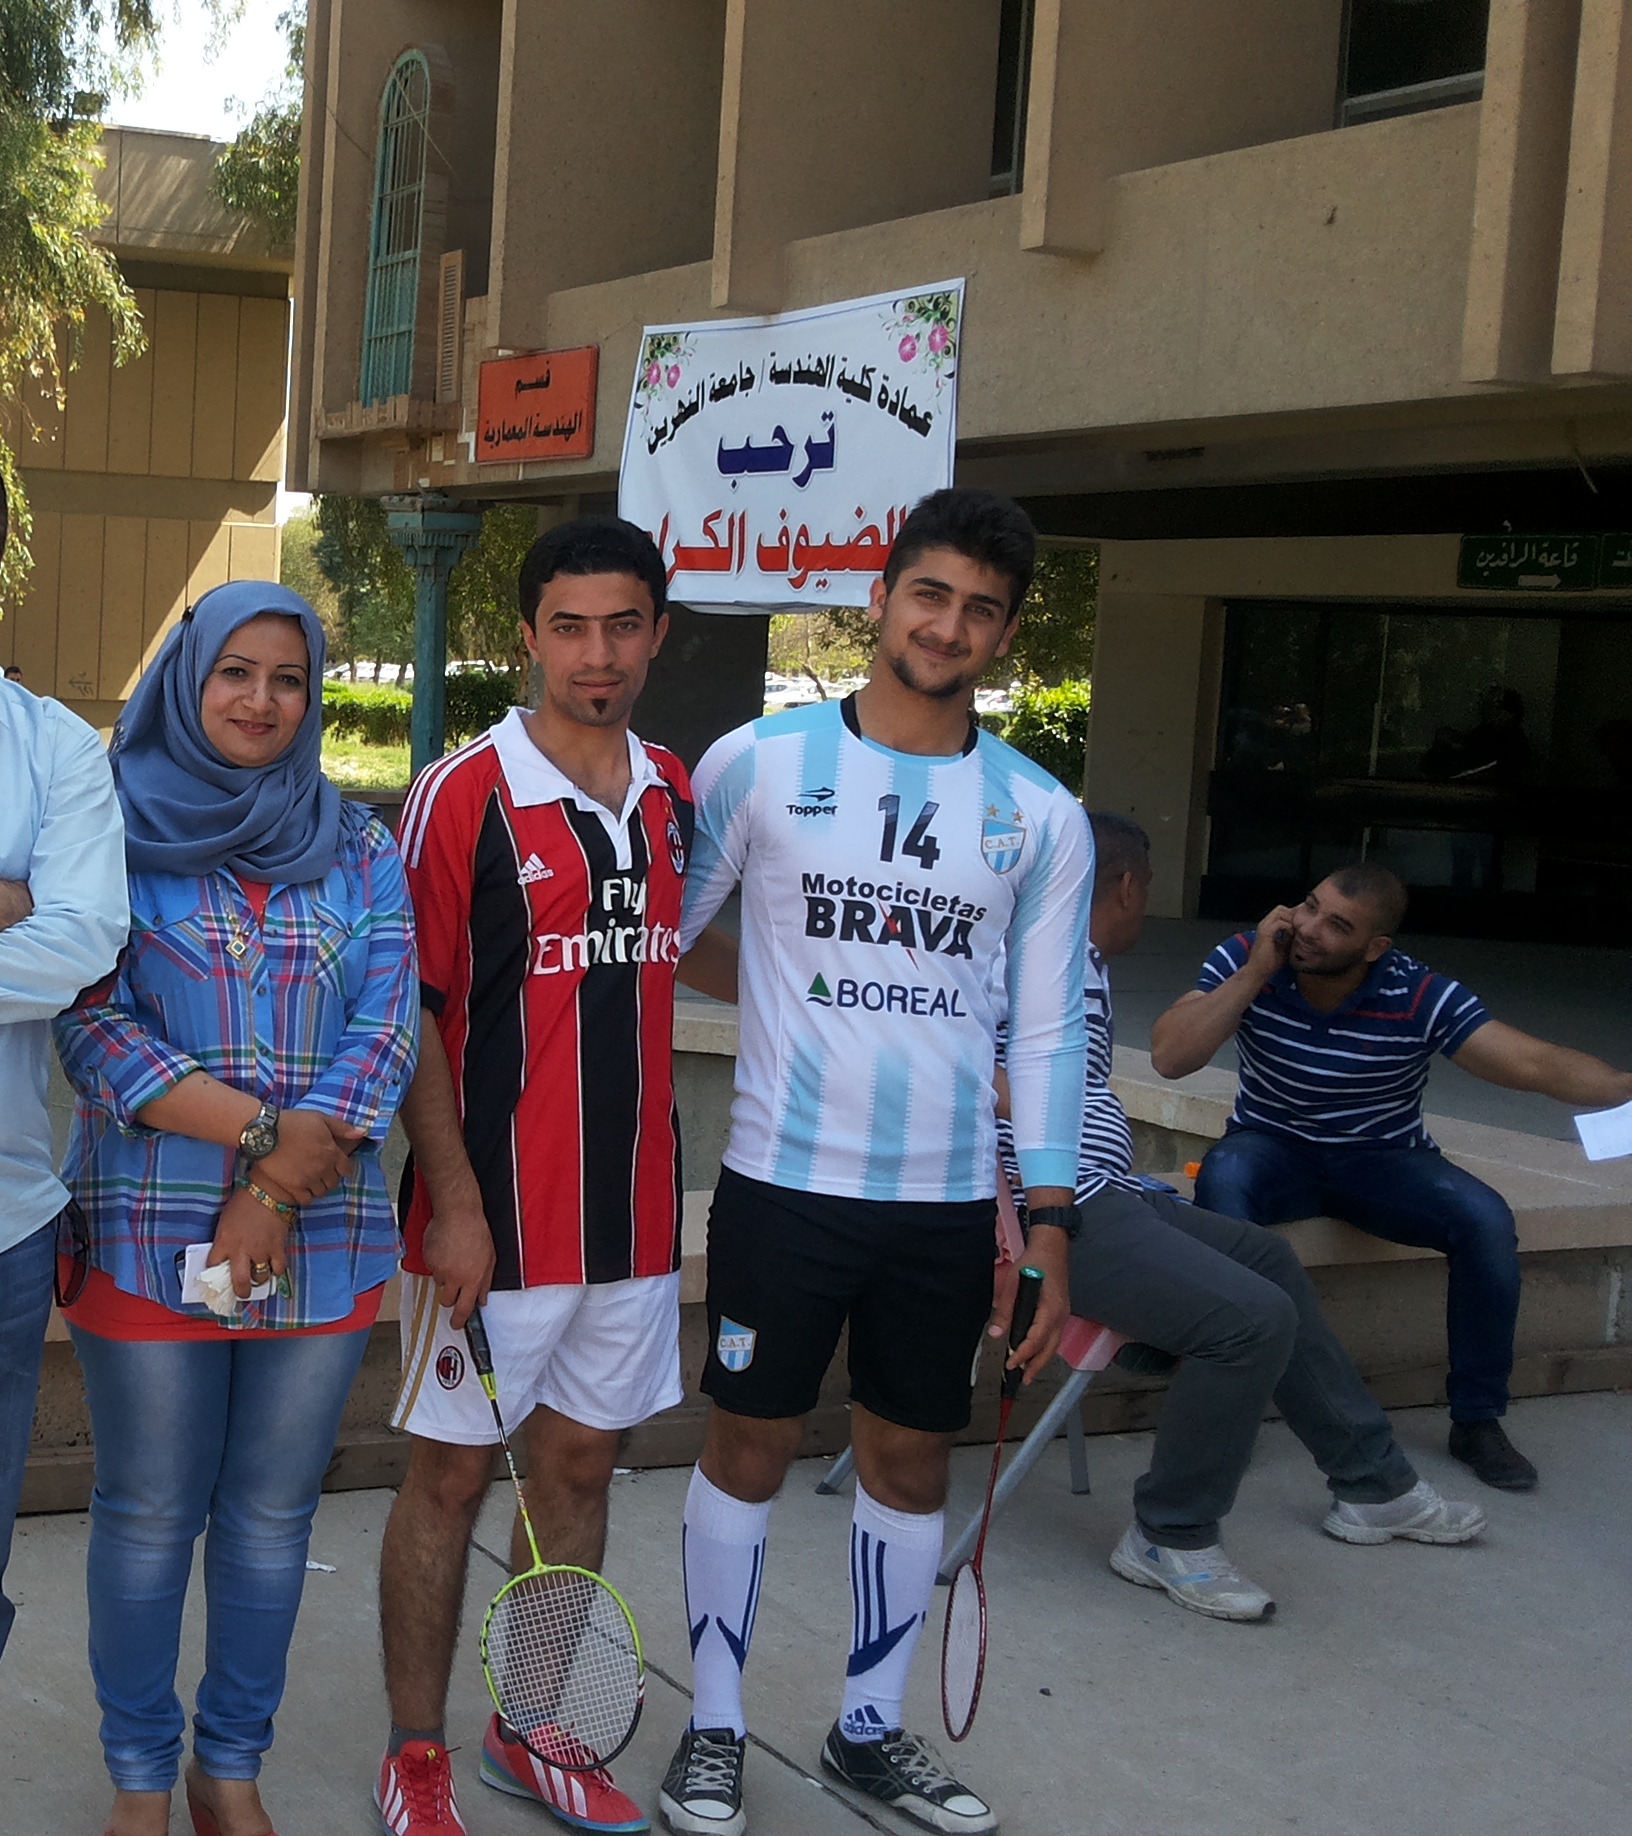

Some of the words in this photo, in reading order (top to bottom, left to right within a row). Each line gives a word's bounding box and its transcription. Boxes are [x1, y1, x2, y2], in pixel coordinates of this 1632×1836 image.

[514, 360, 551, 399] قسم
[708, 360, 756, 404] جامعة
[769, 352, 836, 390] الهندسة
[836, 356, 878, 404] كلية
[532, 410, 583, 442] الهندسة
[647, 378, 705, 456] النهرين
[877, 374, 933, 438] عمادة
[483, 416, 534, 450] المعمارية
[716, 410, 837, 491] ترحب
[649, 507, 747, 589] الكرا
[1475, 541, 1537, 577] الرافدين
[1538, 541, 1580, 569] قاعة
[785, 803, 839, 818] Topper
[877, 793, 941, 870] 14
[517, 868, 555, 886] adidas
[602, 877, 647, 916] Fly
[800, 872, 988, 922] Motocicletas
[803, 895, 975, 960] BRAVA
[835, 977, 968, 1018] BOREAL
